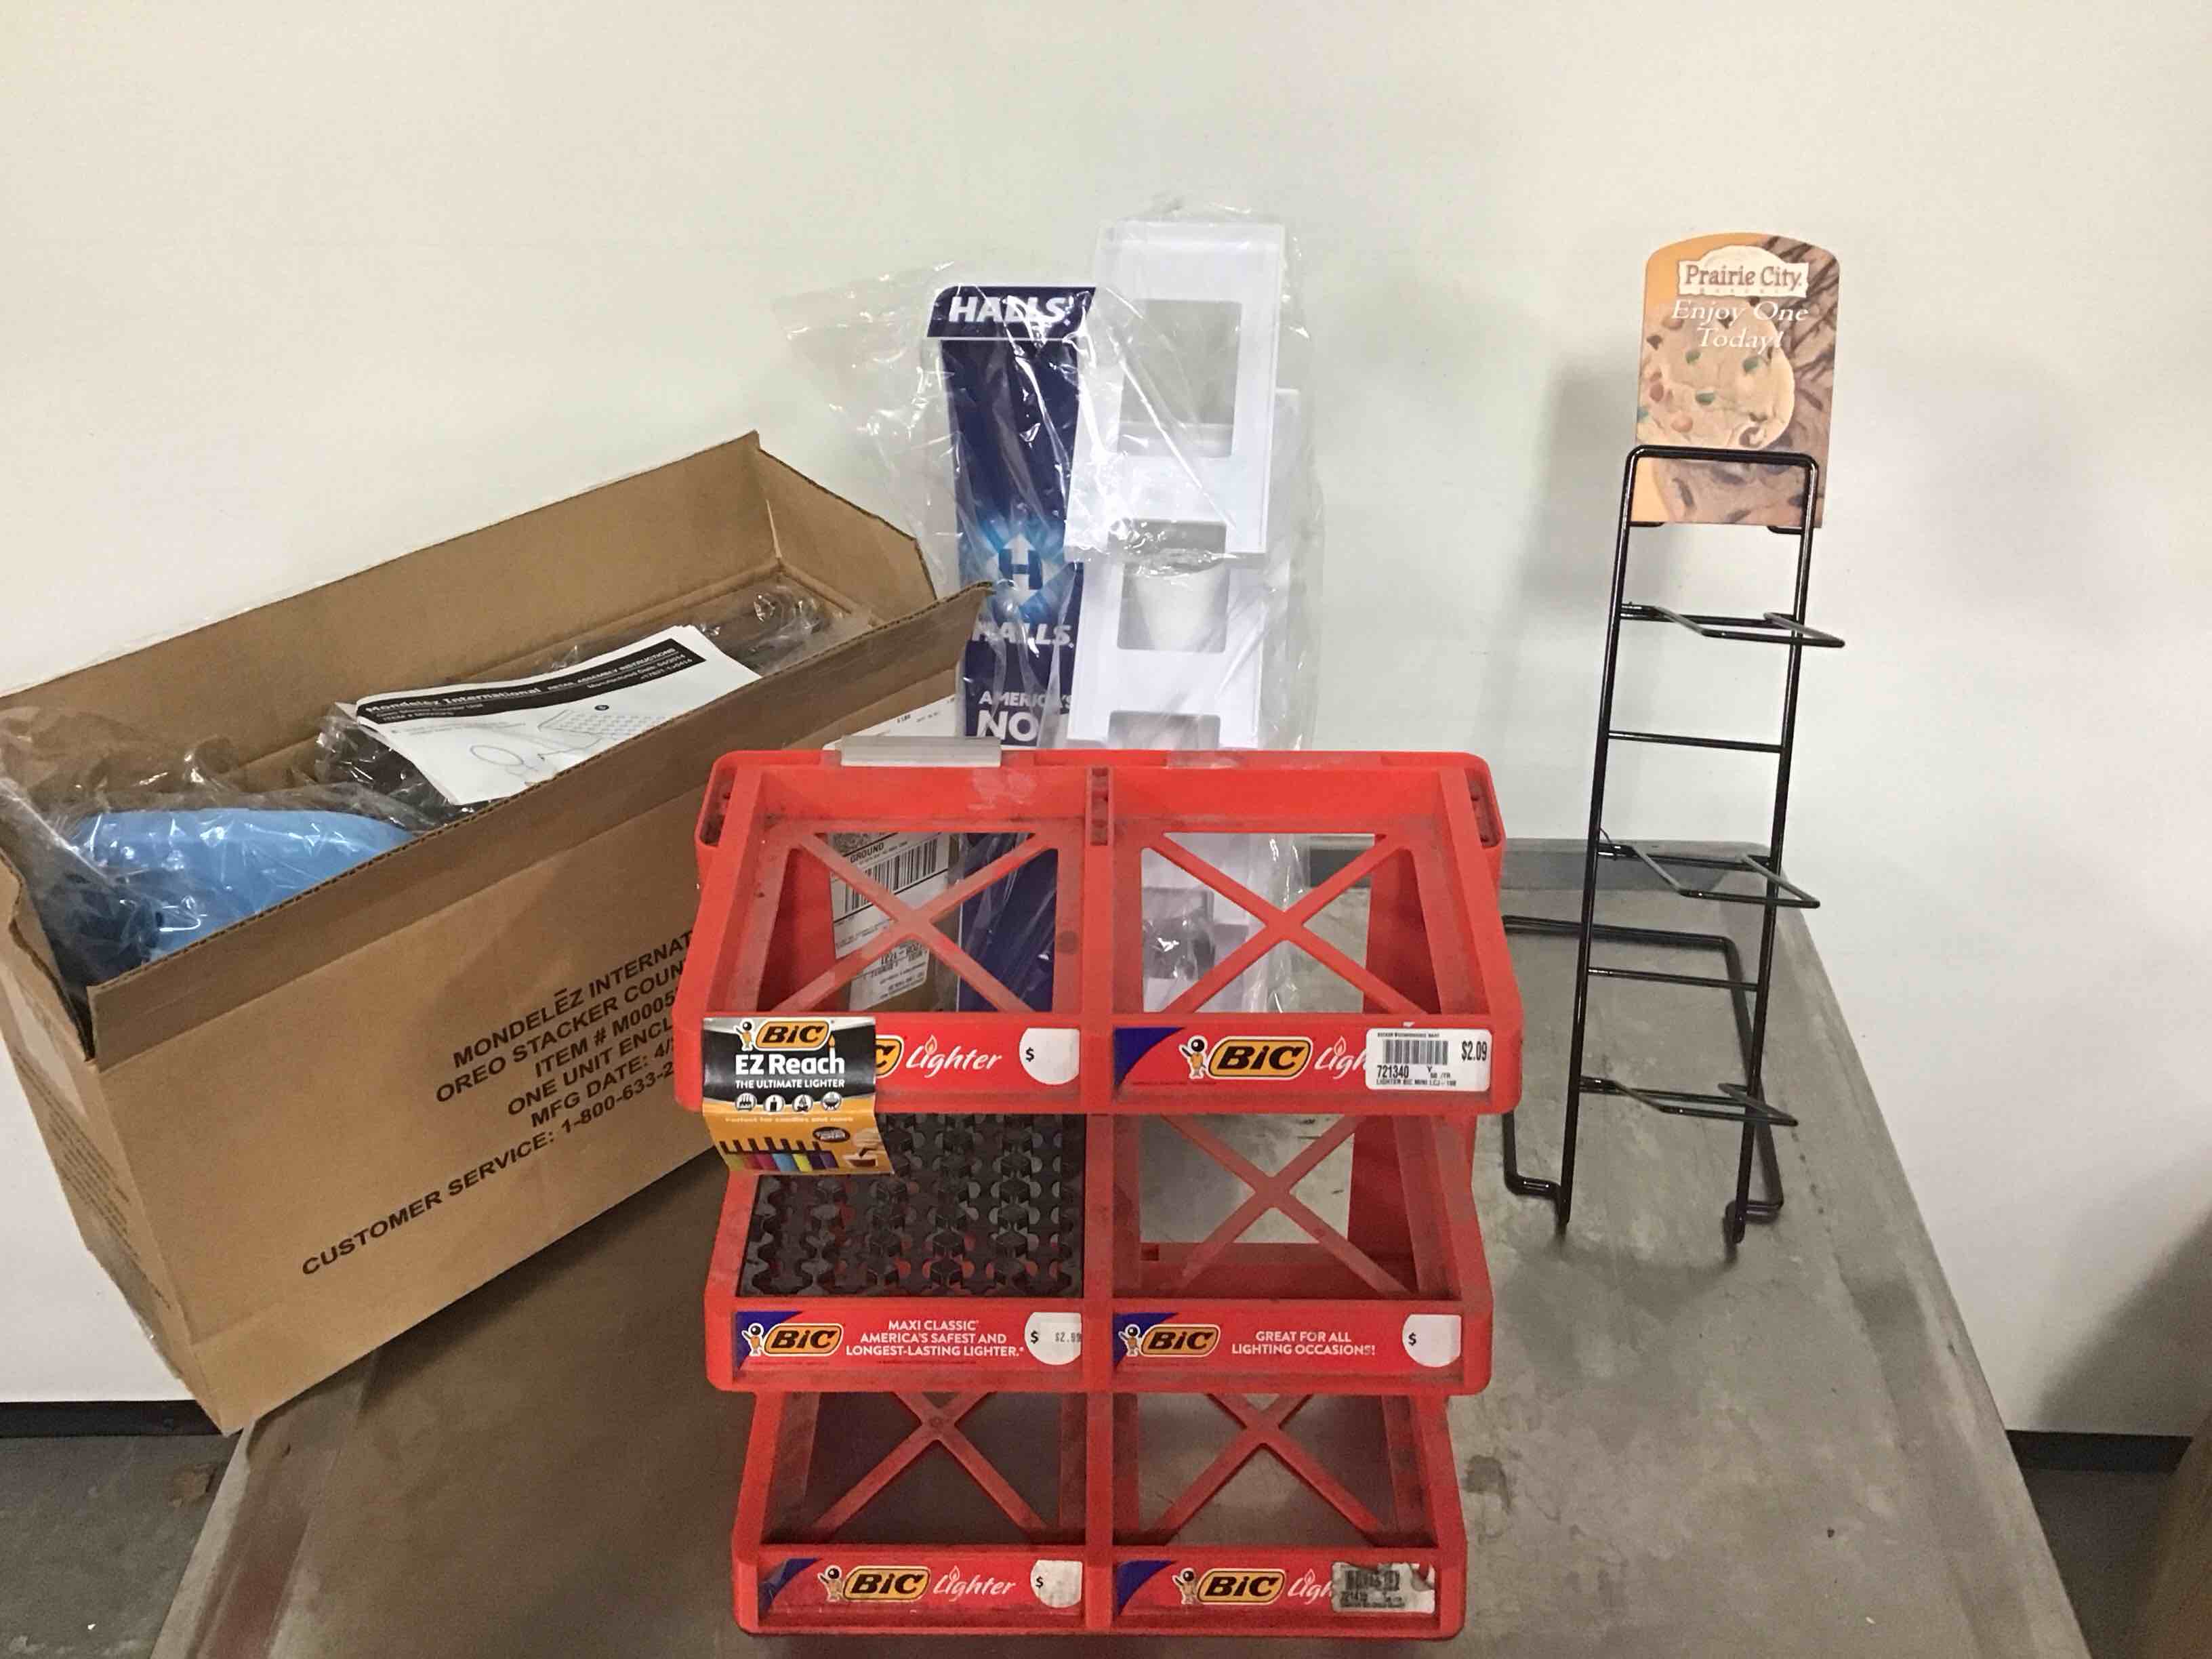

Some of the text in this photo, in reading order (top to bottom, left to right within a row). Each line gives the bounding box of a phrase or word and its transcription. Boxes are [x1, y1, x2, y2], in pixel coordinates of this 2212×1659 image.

[1684, 264, 1755, 286] Prairie
[1671, 300, 1809, 327] Enjoy One
[1696, 327, 1784, 354] Today!
[849, 842, 885, 863] GROUND
[436, 960, 686, 1103] OREO STACKER COUN
[534, 987, 678, 1078] ITEM # M0005
[1025, 1046, 1036, 1062] $
[1461, 1040, 1488, 1061] $2.09
[735, 1047, 846, 1076] EZ Reach
[905, 1045, 1003, 1079] Lighter
[1376, 1065, 1410, 1079] 721340
[508, 1079, 558, 1115] ONE
[562, 1047, 613, 1086] UNIT
[531, 1037, 674, 1128] MFG DATE: 4/
[735, 1078, 846, 1088] THE ULTIMATE LIGHTER
[301, 1190, 444, 1275] CUSTOMER
[447, 1129, 555, 1197] SERVICE:
[888, 1319, 977, 1332] MAXI CLASSIC
[860, 1332, 1007, 1344] AMERICA'S SAFEST AND
[1030, 1330, 1040, 1345] $
[1255, 1330, 1352, 1343] GREAT FOR ALL
[1408, 1332, 1417, 1347] $
[846, 1345, 961, 1356] LONGEST-LASTING
[1231, 1343, 1376, 1356] LIGHTING OCCASIONS!
[932, 1574, 1017, 1602] Lighter
[1035, 1576, 1044, 1589] $
